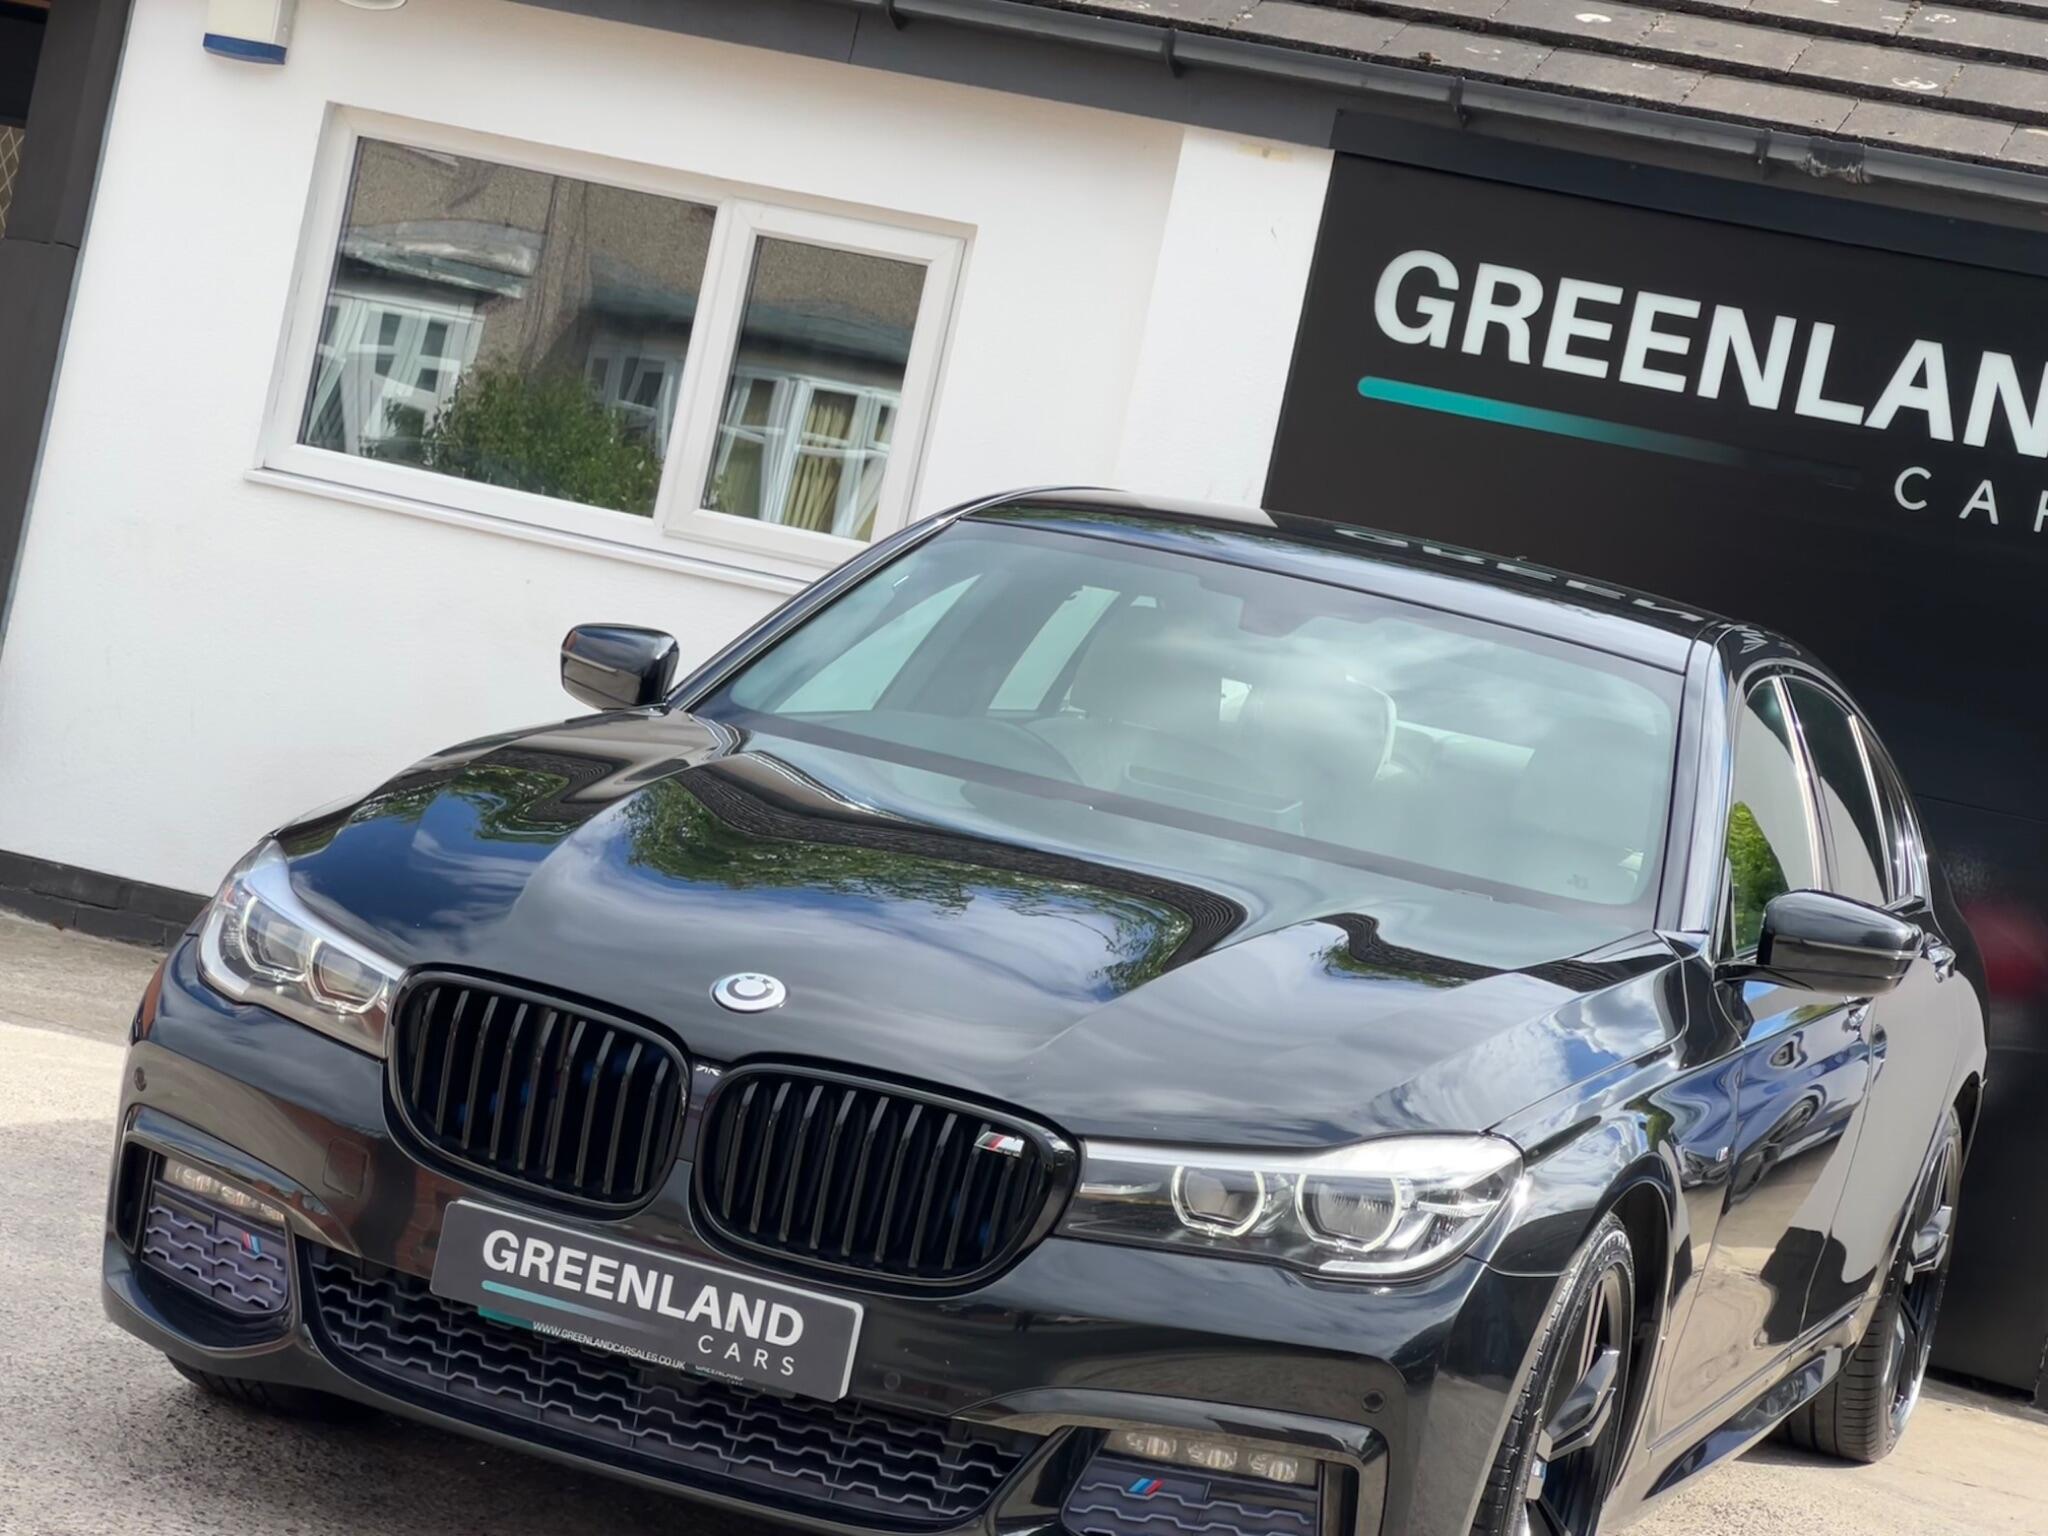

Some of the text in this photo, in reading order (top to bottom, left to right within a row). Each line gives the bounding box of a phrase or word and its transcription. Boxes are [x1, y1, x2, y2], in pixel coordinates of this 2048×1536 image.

[482, 1229, 804, 1347] GREENLAND
[532, 1321, 686, 1370] WWW.GREENLANDCARSALES.CO.UK
[698, 1334, 795, 1376] CARS
